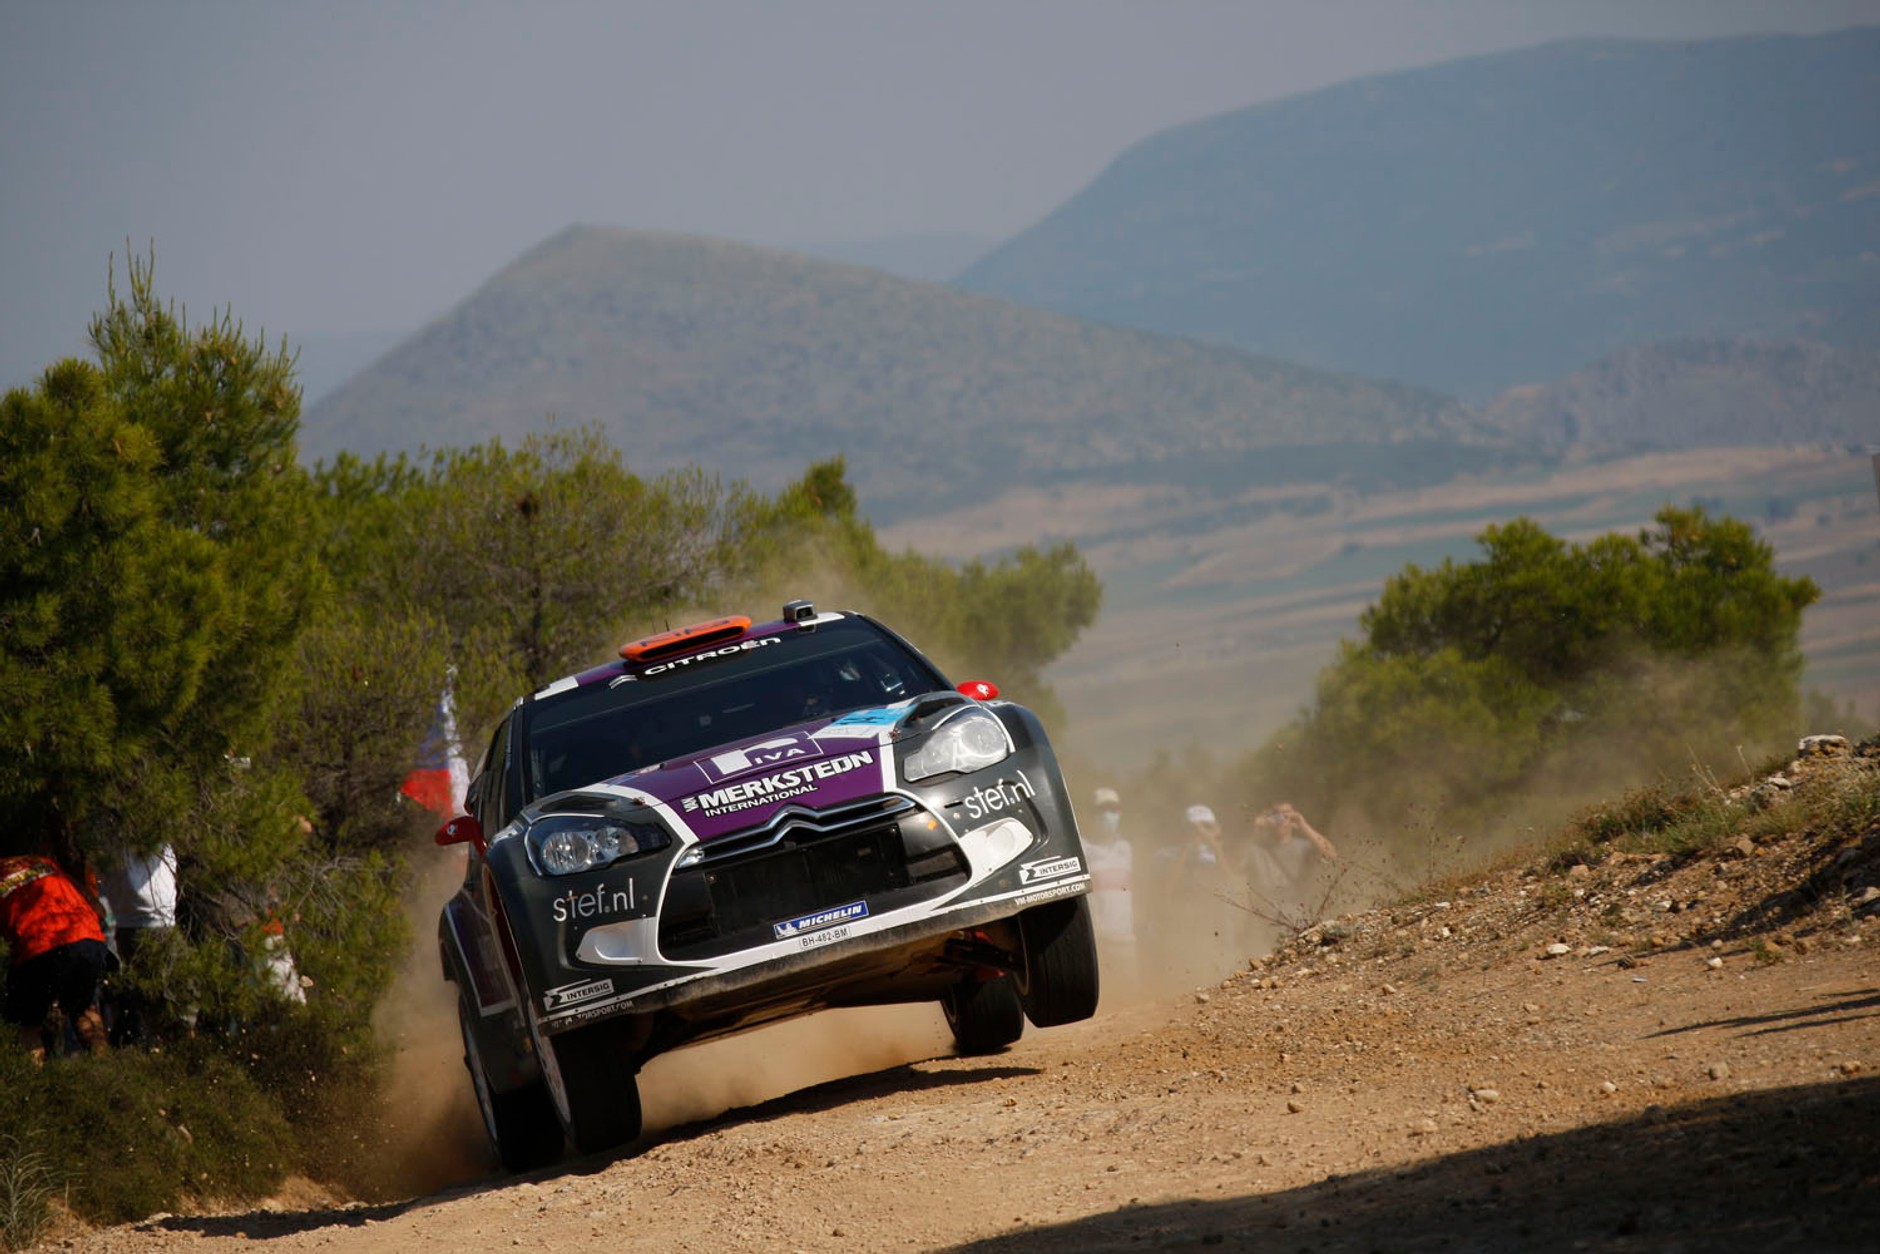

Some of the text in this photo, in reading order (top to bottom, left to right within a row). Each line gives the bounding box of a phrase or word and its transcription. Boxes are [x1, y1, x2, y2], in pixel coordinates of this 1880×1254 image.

[705, 785, 818, 817] INTERNATIONAL
[964, 769, 1036, 819] stef.nl
[1039, 860, 1078, 875] INTERSIG
[553, 877, 635, 922] stef.nl
[799, 905, 862, 929] MICHELIN
[566, 982, 611, 1001] INTERSIG
